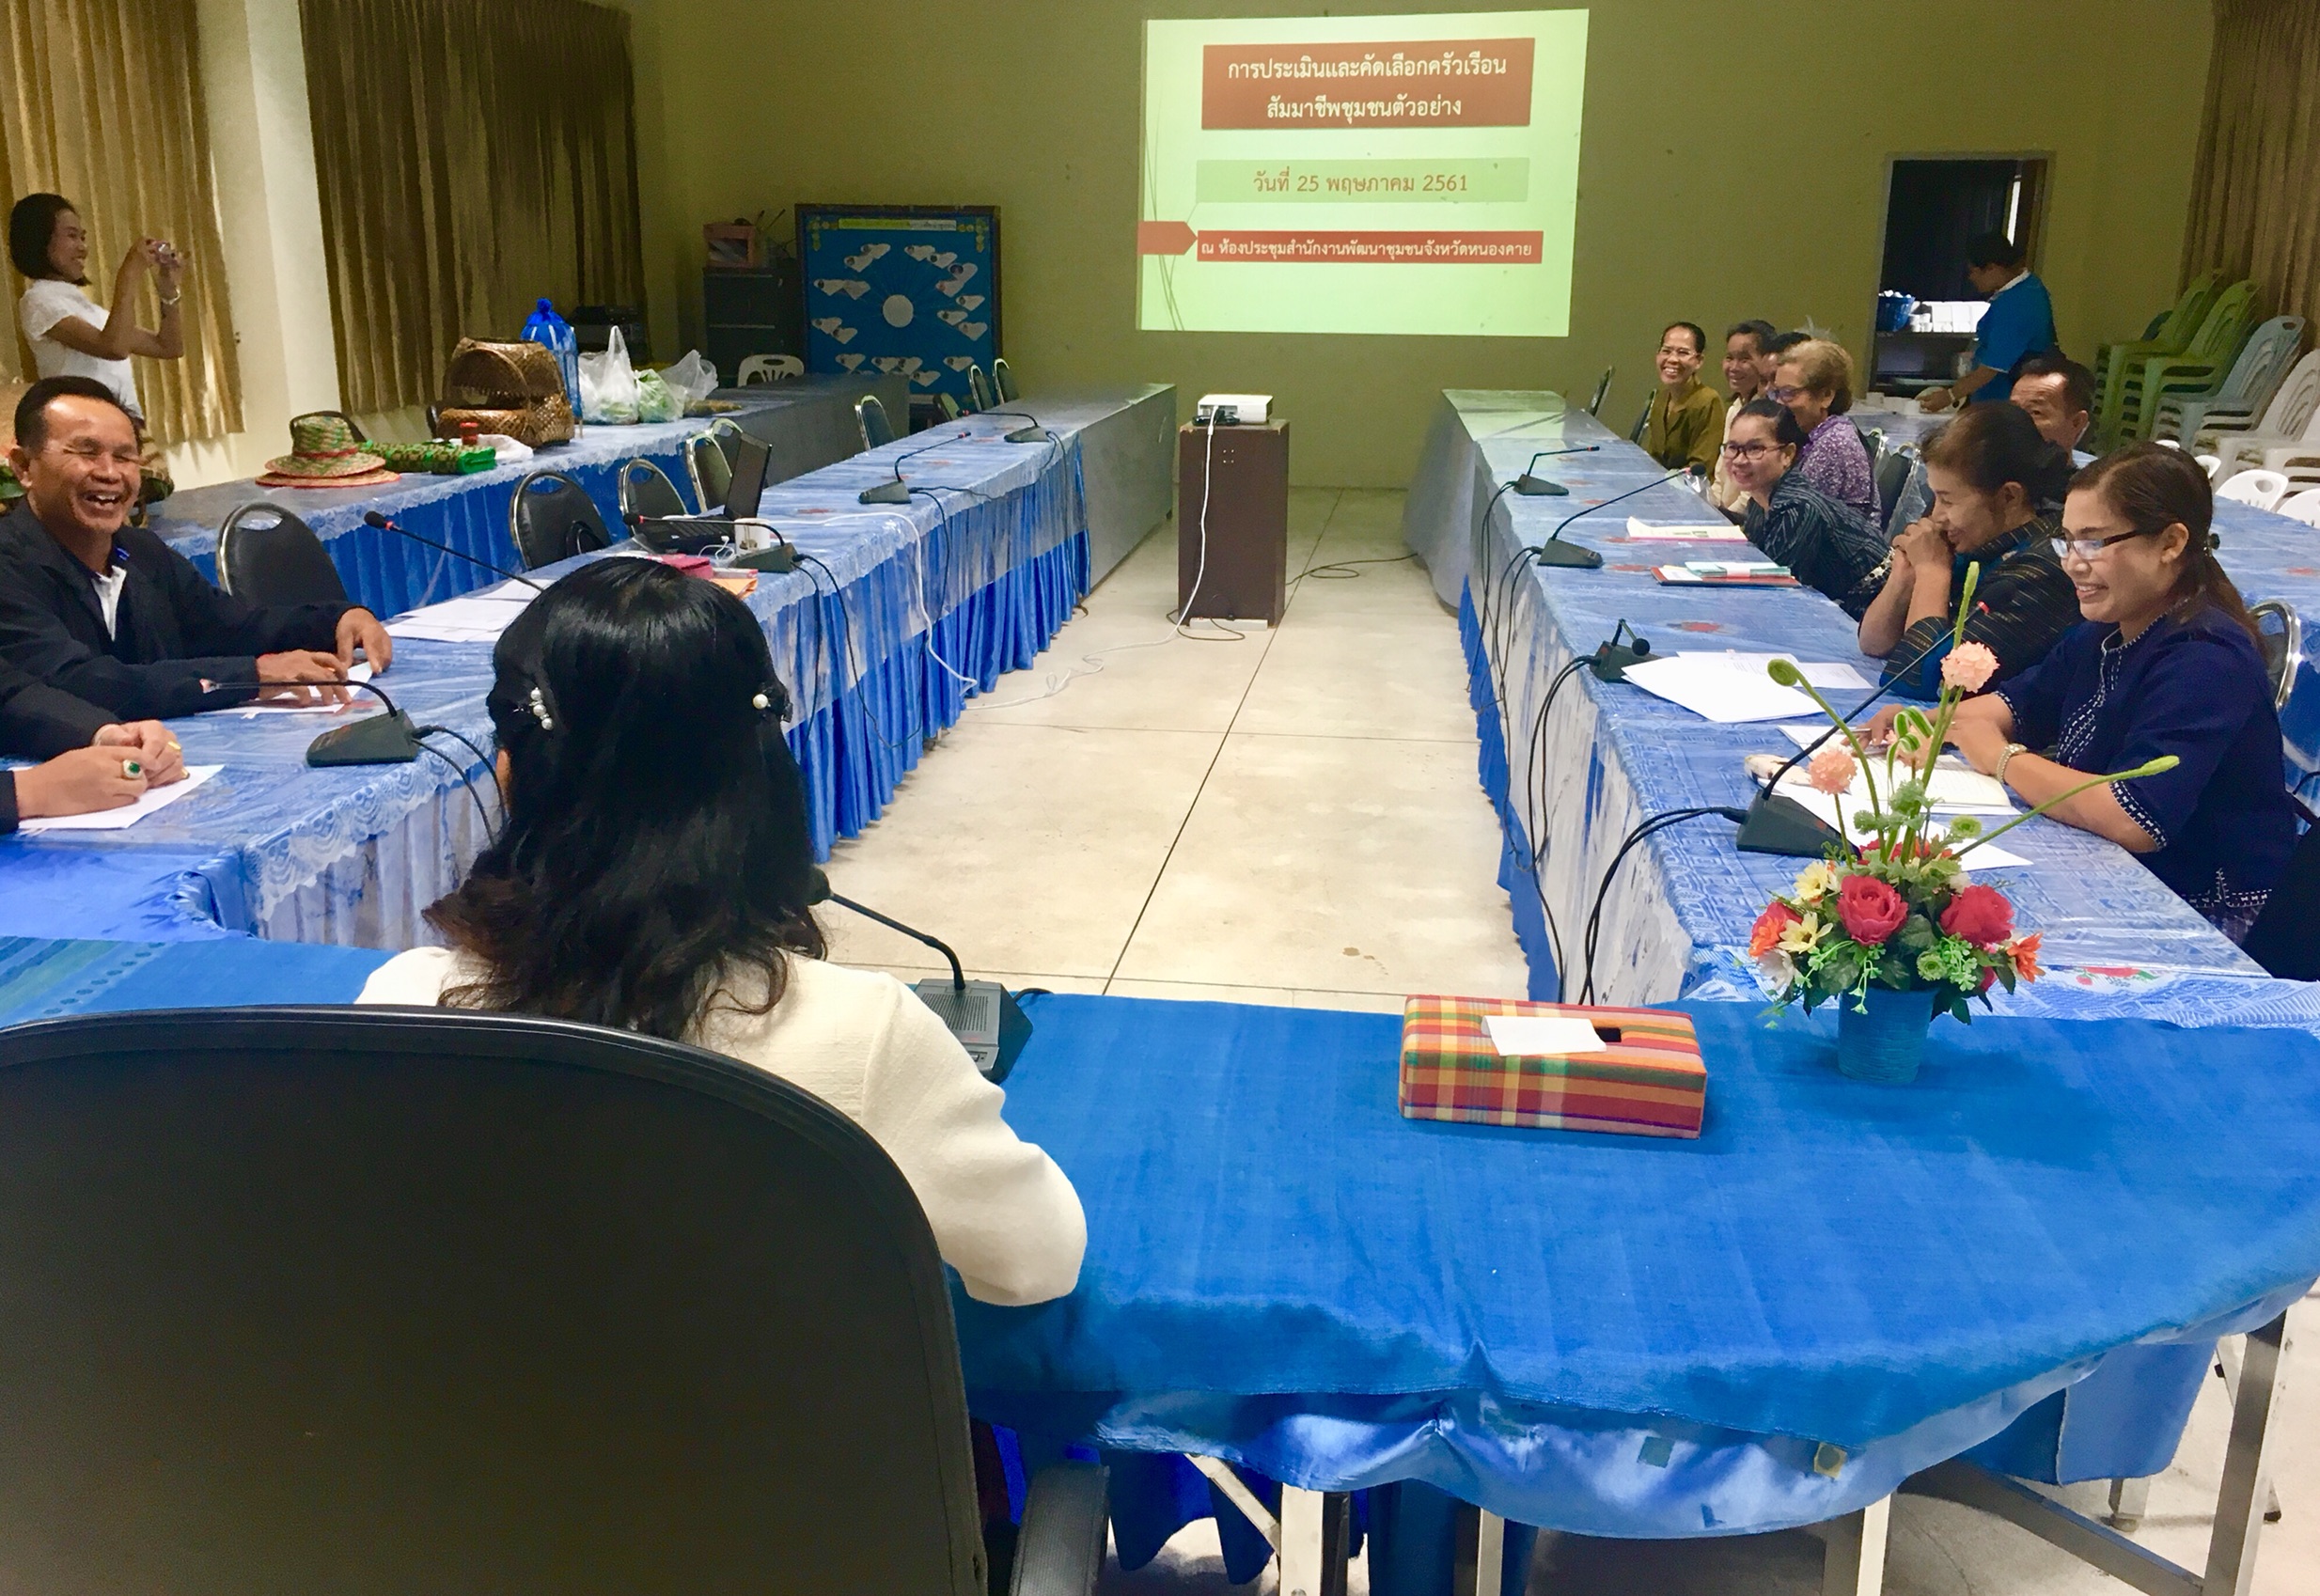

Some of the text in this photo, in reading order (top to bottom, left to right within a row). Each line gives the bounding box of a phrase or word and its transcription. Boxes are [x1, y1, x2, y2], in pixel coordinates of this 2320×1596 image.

[1228, 51, 1507, 79] การประเมินและคัดเลือกครัวเรือน
[1267, 93, 1462, 124] สัมมาชีพชุมชนตัวอย่าง
[1253, 166, 1467, 196] วันที่ 25 พฤษภาคม 2561
[1201, 239, 1532, 259] ณ ห้องประชุมสำนักงานพัฒนาชุมชนจังหวัดหนองคาย
